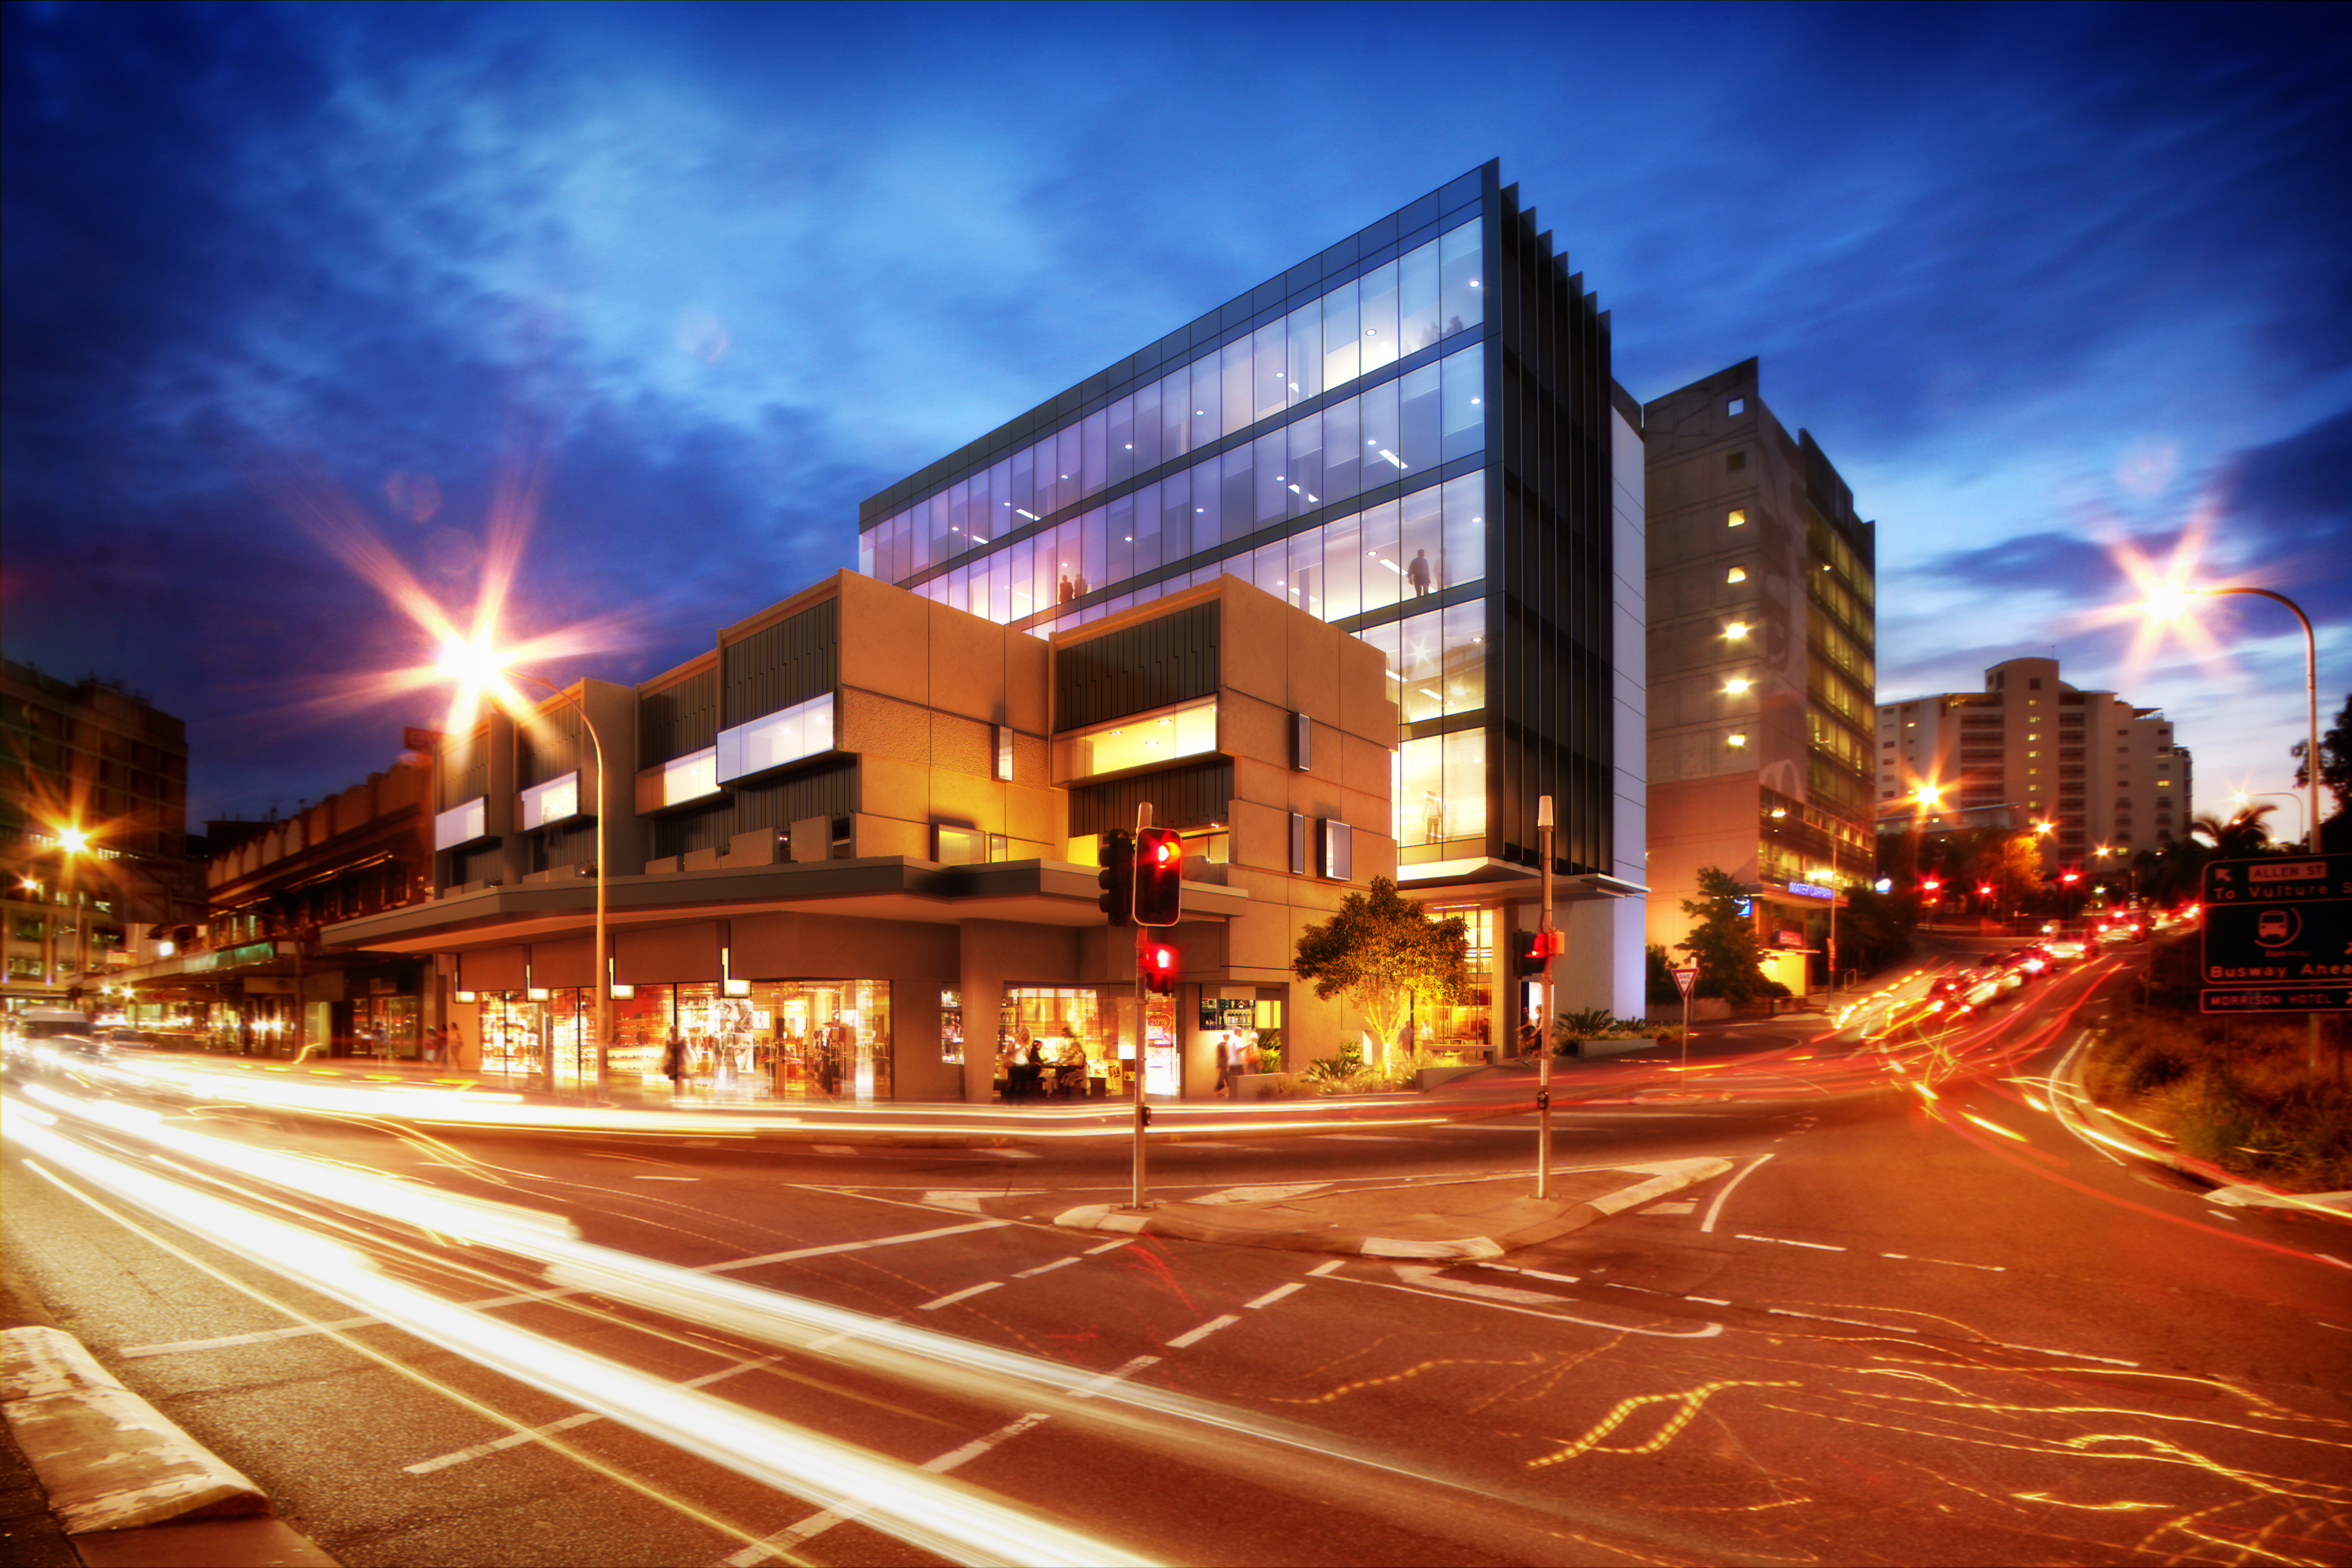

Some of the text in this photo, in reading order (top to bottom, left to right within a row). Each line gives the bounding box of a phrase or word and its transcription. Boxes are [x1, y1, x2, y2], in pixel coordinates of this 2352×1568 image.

[2253, 864, 2323, 878] ALLEN ST
[2214, 887, 2236, 899] To
[2249, 884, 2328, 898] Vulture
[2210, 963, 2352, 979] Busway Ahea
[2210, 994, 2333, 1006] MORRISON HOTEL
